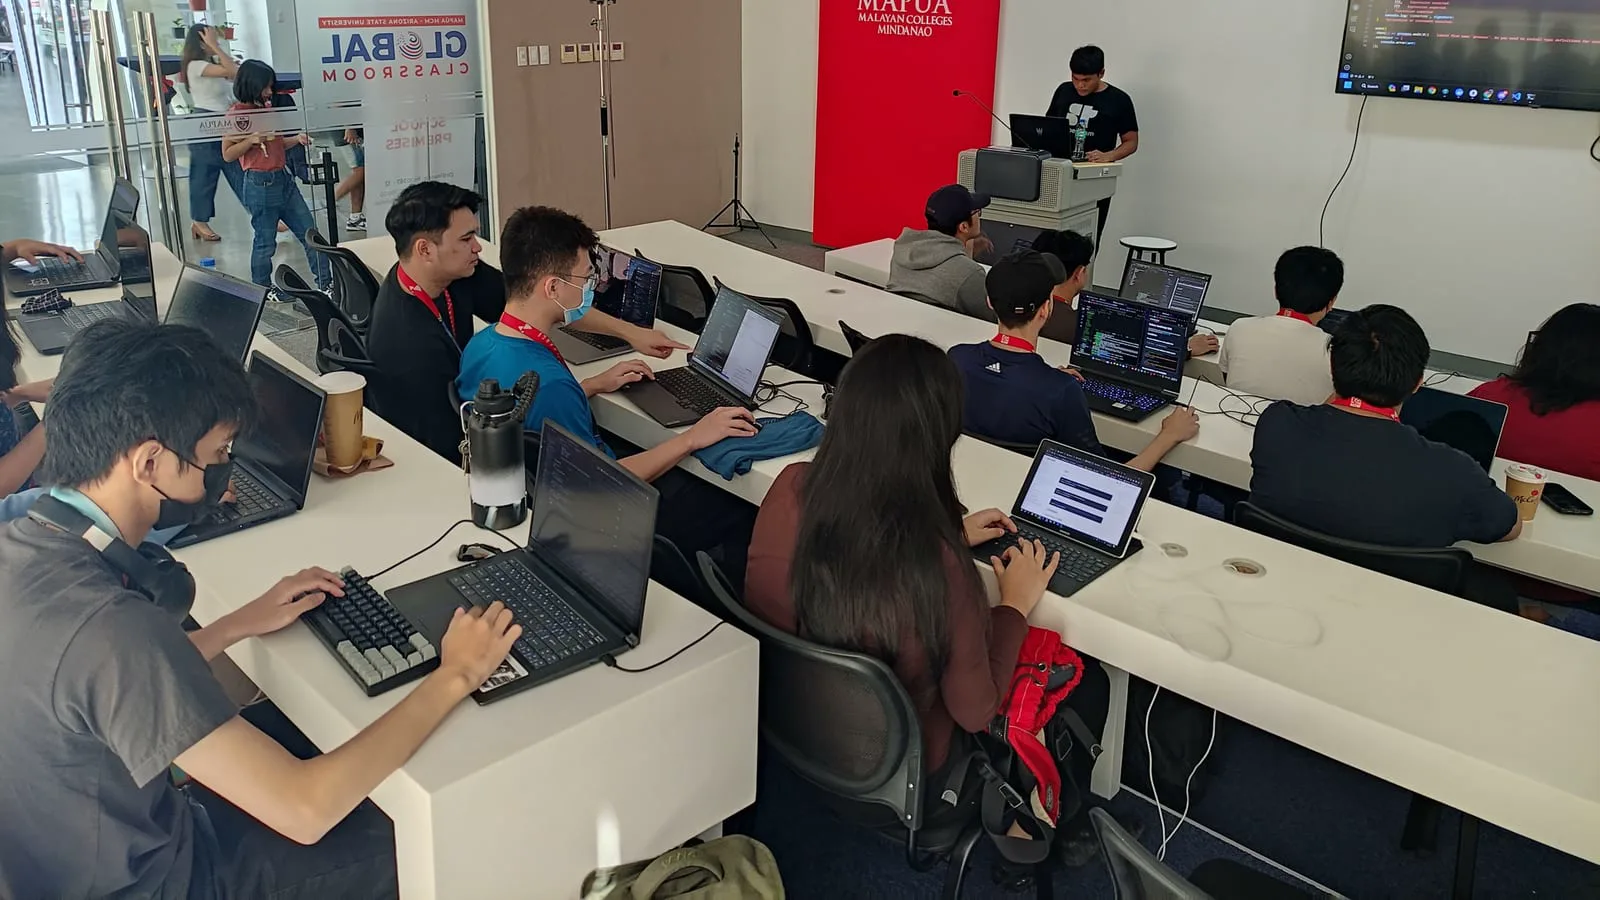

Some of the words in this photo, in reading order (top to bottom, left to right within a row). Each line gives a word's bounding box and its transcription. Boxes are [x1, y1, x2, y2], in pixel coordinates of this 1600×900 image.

[858, 13, 905, 24] MALAYAN
[906, 15, 953, 26] COLLEGES
[877, 24, 933, 37] MINDANAO
